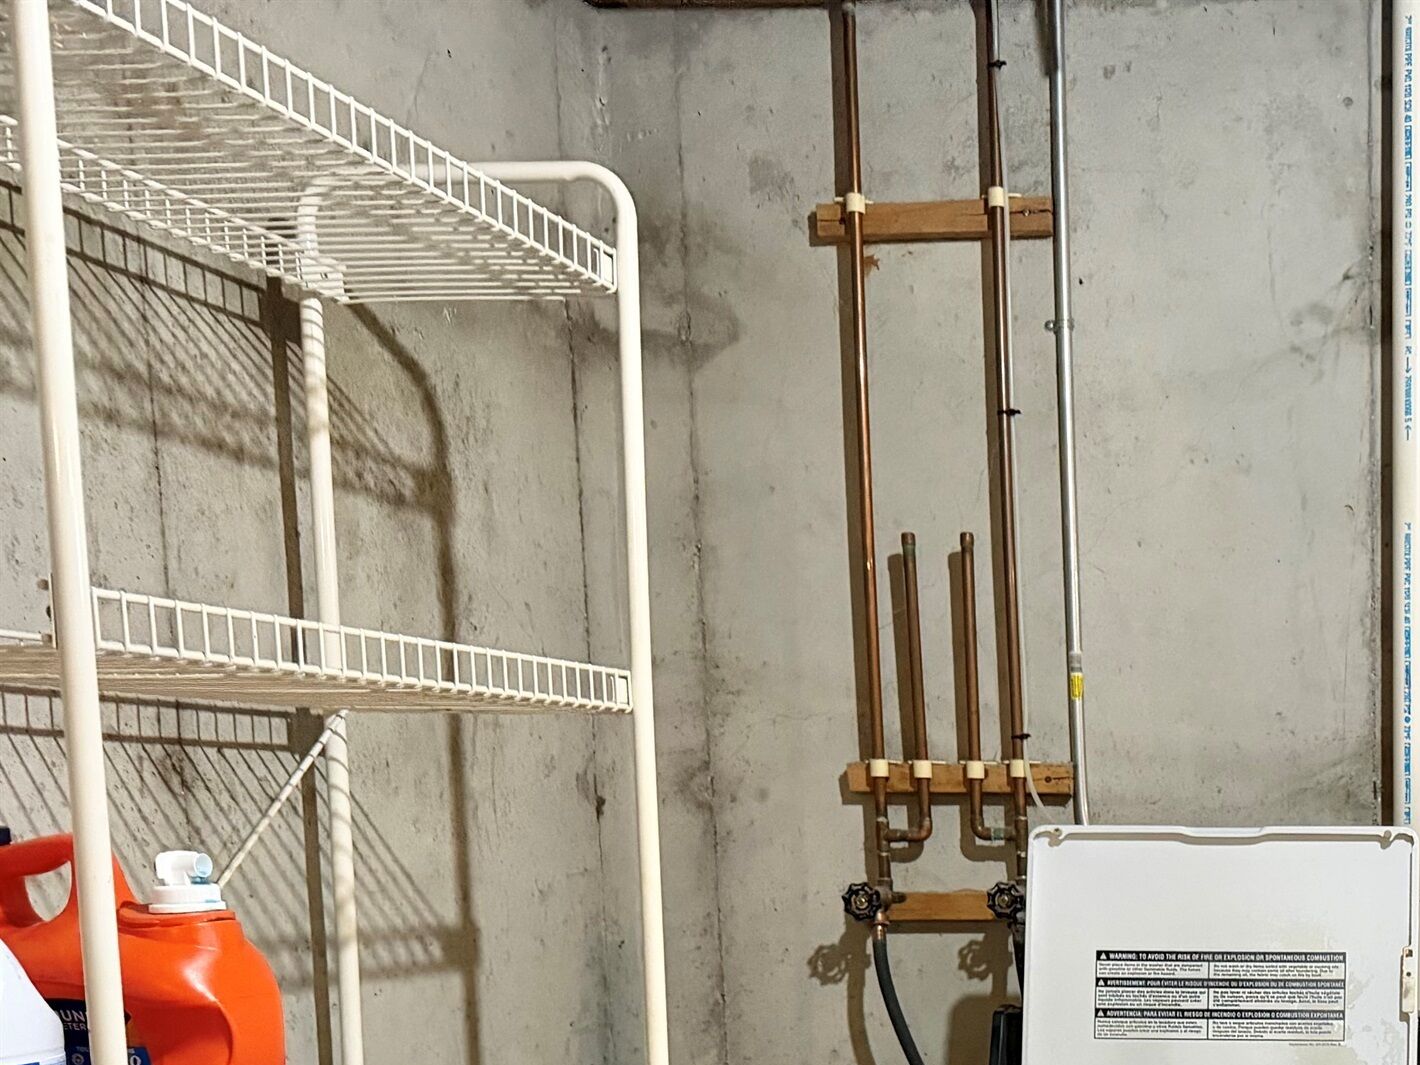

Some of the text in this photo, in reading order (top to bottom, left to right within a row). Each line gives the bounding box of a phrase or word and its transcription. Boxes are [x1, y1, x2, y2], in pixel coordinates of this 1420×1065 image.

[1223, 953, 1254, 961] EXPLOSION
[1265, 953, 1306, 961] SPONTANEOUS
[1306, 953, 1344, 961] COMBUSTION
